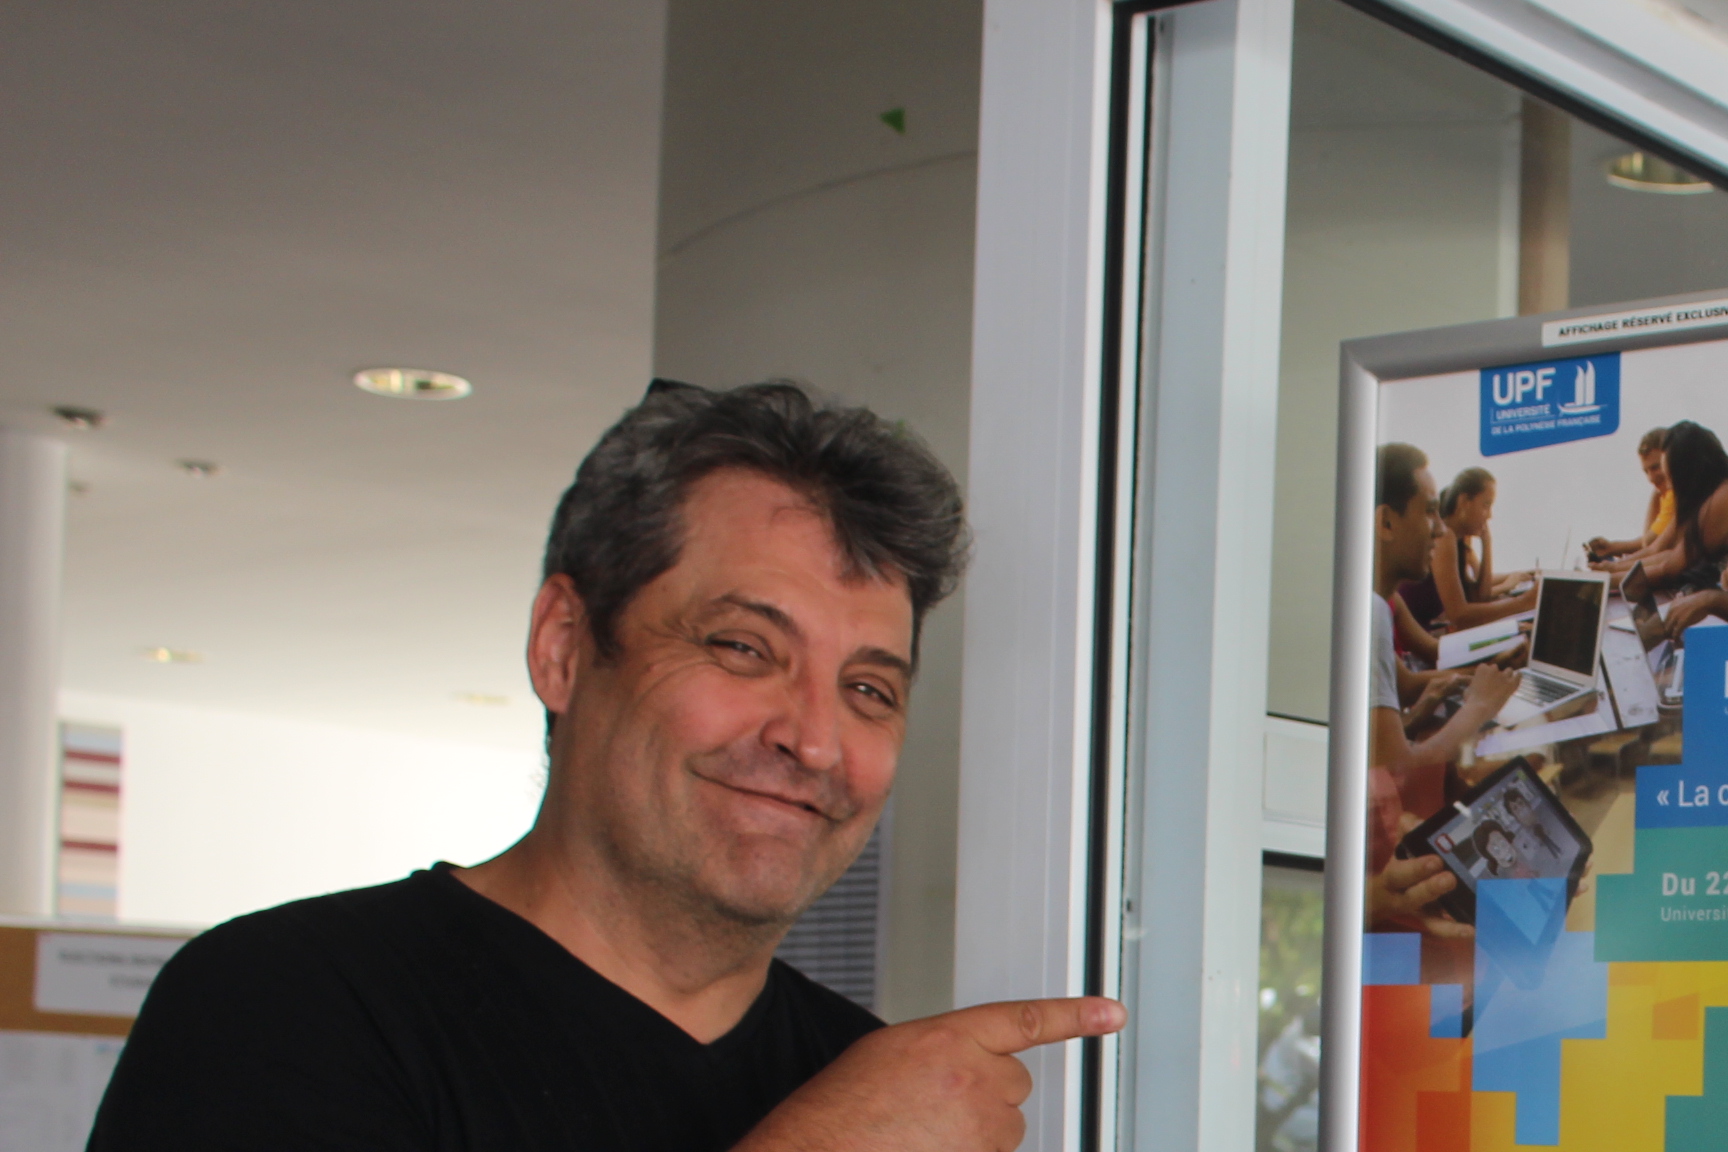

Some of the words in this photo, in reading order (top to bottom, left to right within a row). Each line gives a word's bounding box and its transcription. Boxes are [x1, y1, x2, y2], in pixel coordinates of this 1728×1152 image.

[1559, 319, 1620, 337] AFFICHAGE
[1622, 310, 1673, 328] RÉSERVÉ
[1493, 367, 1556, 405] UPF
[1678, 779, 1709, 808] La
[1662, 872, 1696, 896] Du
